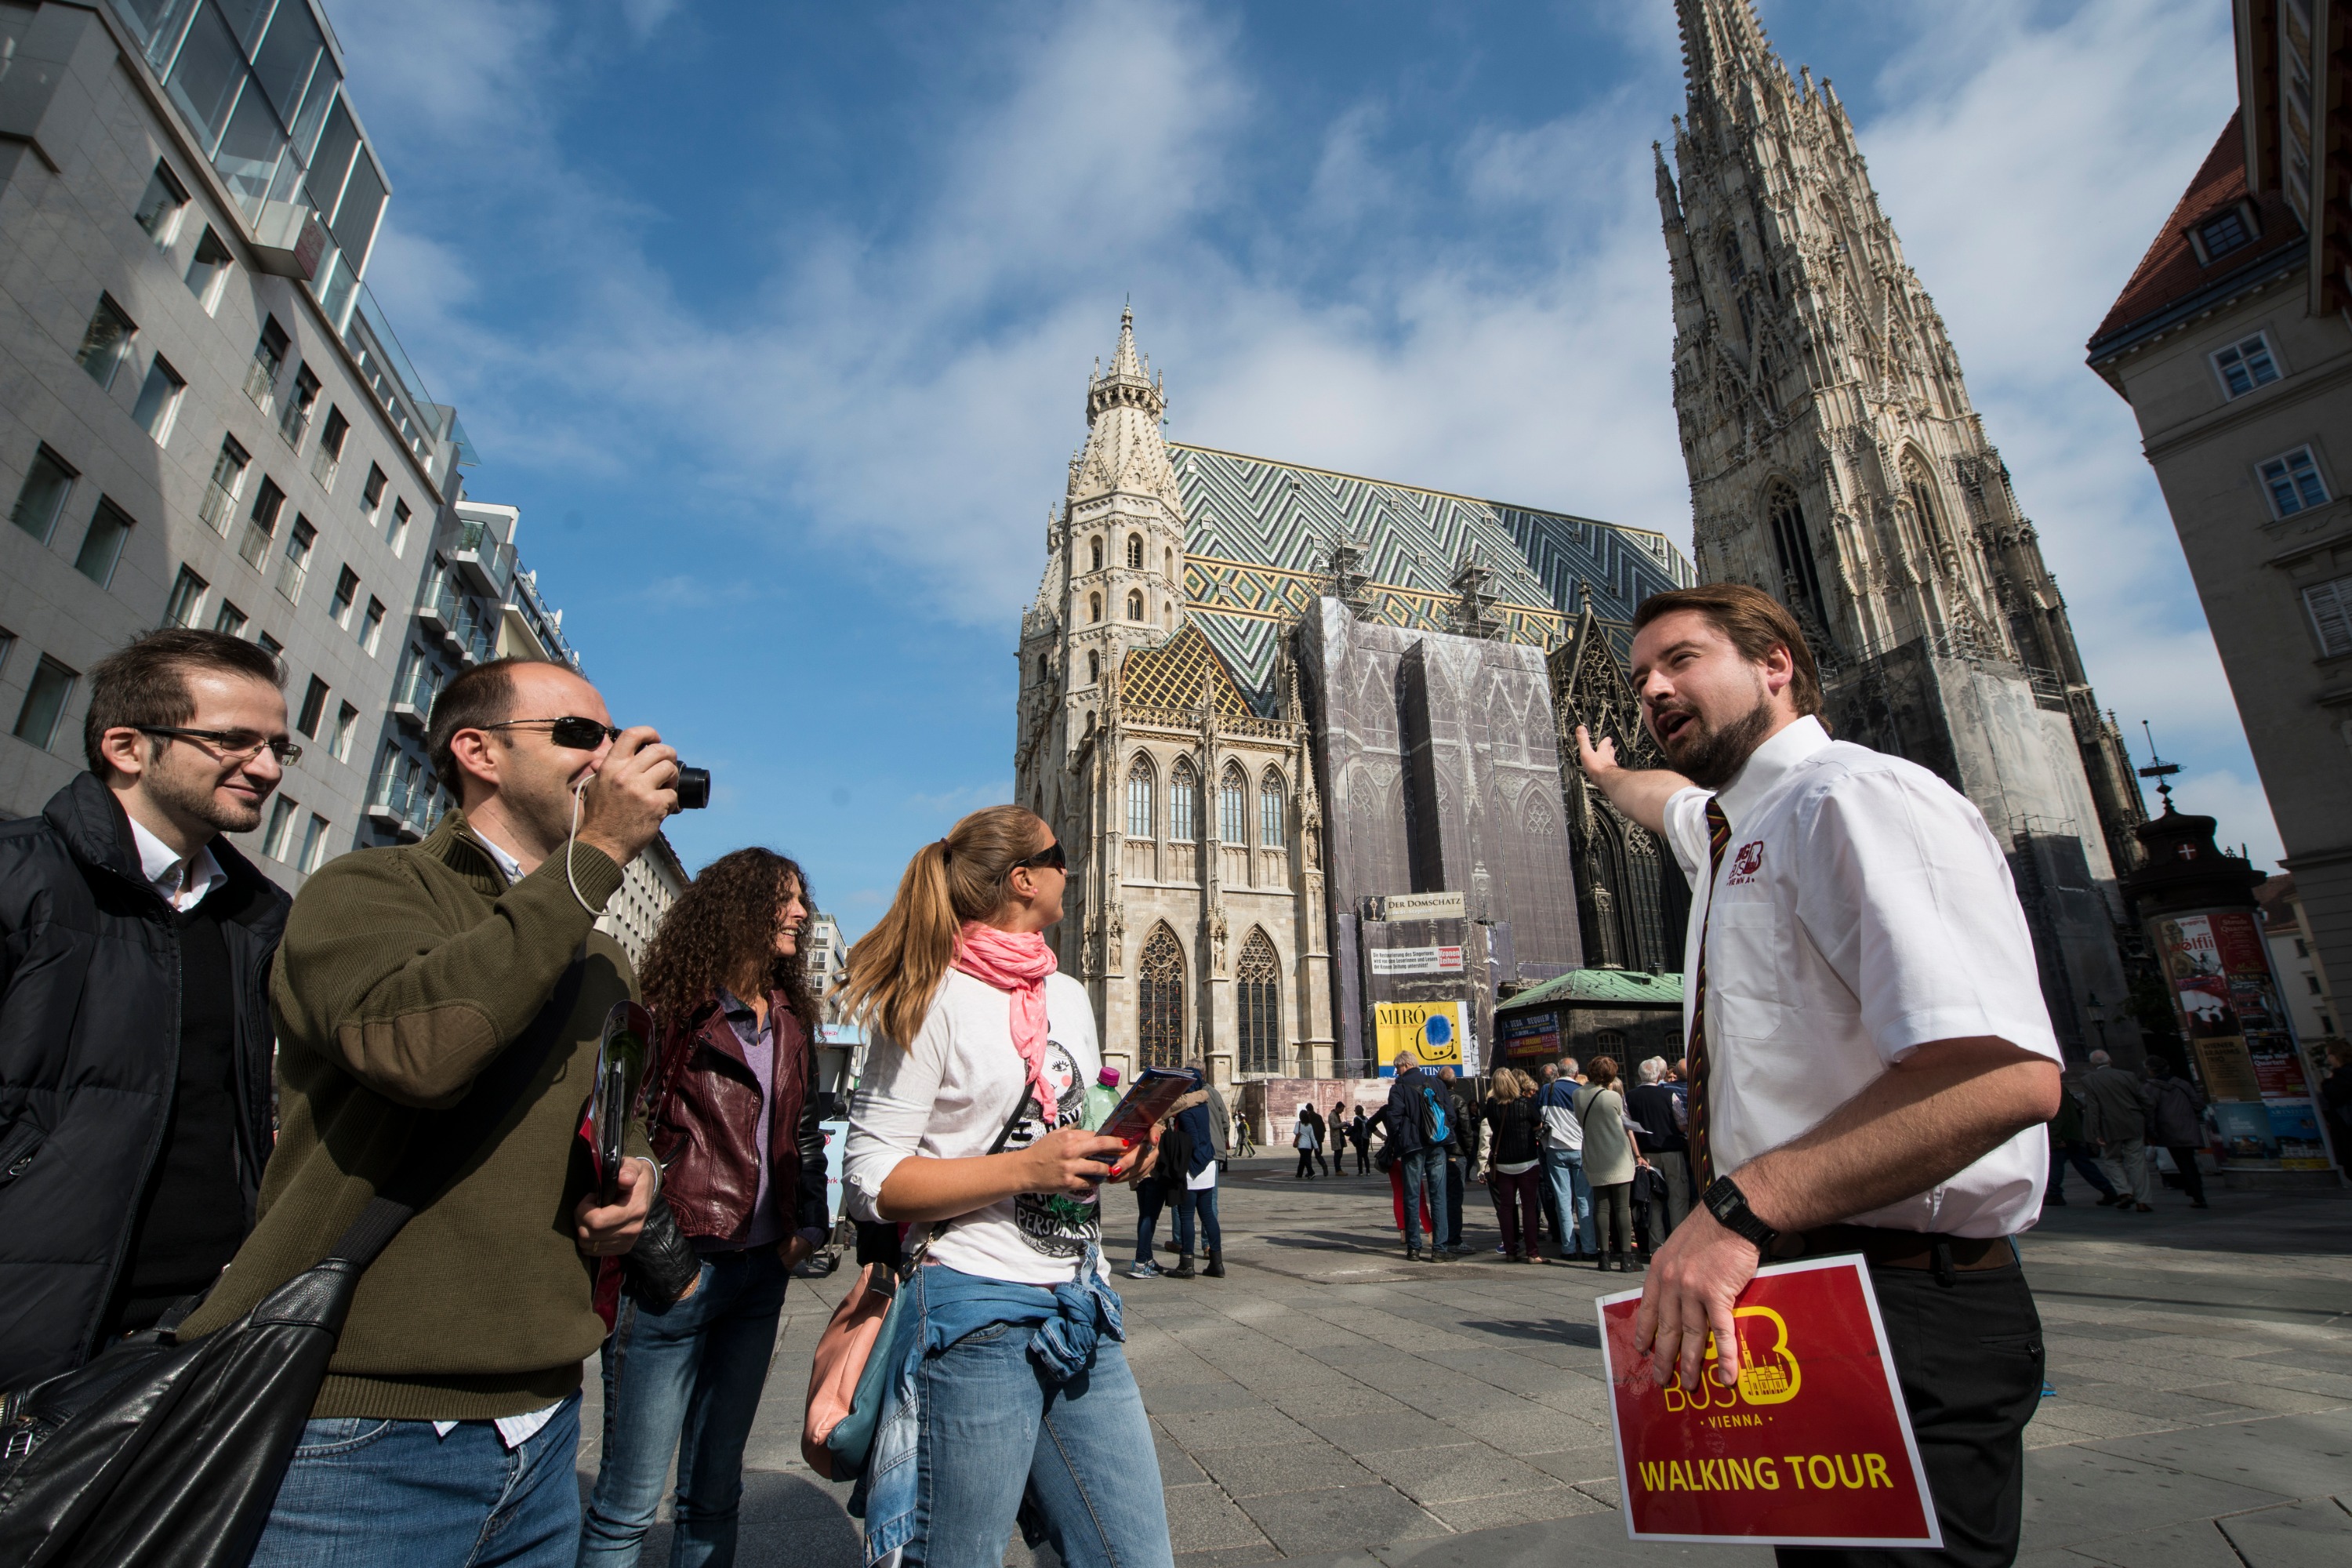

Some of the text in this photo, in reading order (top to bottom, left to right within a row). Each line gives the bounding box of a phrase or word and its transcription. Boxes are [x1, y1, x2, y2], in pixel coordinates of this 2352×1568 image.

[1407, 898, 1461, 907] DOMSCHATZ
[1379, 1005, 1426, 1025] MIRÓ
[1708, 1414, 1762, 1428] VIENNA
[1639, 1453, 1894, 1492] WALKING TOUR
